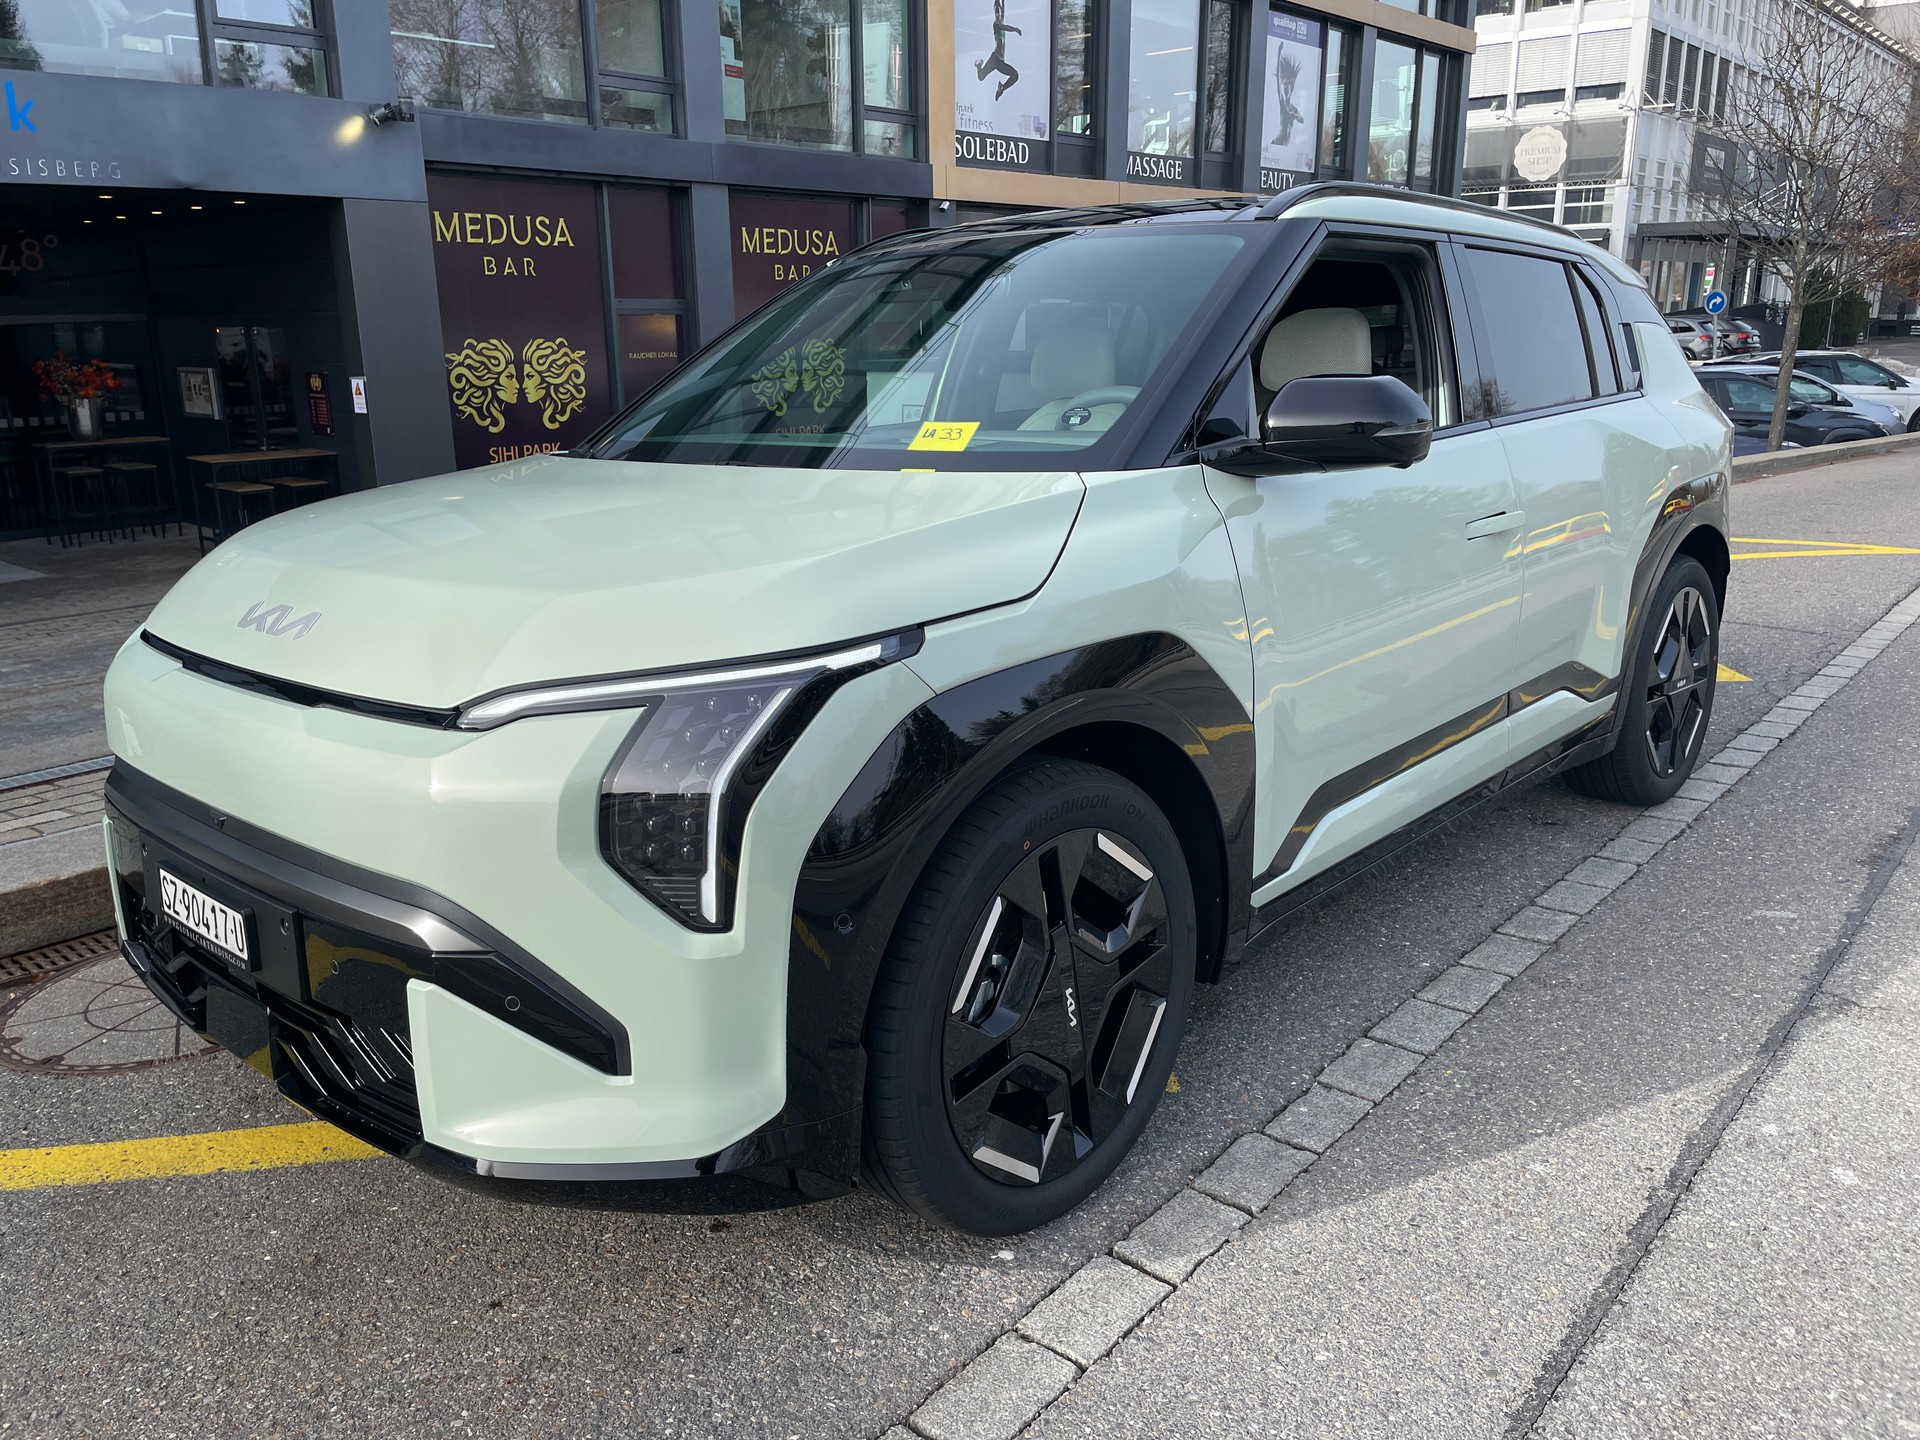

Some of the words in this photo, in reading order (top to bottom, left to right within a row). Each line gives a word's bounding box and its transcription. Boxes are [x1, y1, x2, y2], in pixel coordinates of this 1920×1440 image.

[960, 114, 994, 131] fitness
[955, 135, 1029, 164] SOLEBAD
[1520, 146, 1561, 157] PREMIUM
[433, 211, 575, 247] MEDUSA
[741, 227, 840, 256] MEDUSA
[483, 256, 537, 276] BAR
[921, 428, 938, 439] LA
[939, 427, 963, 441] 33
